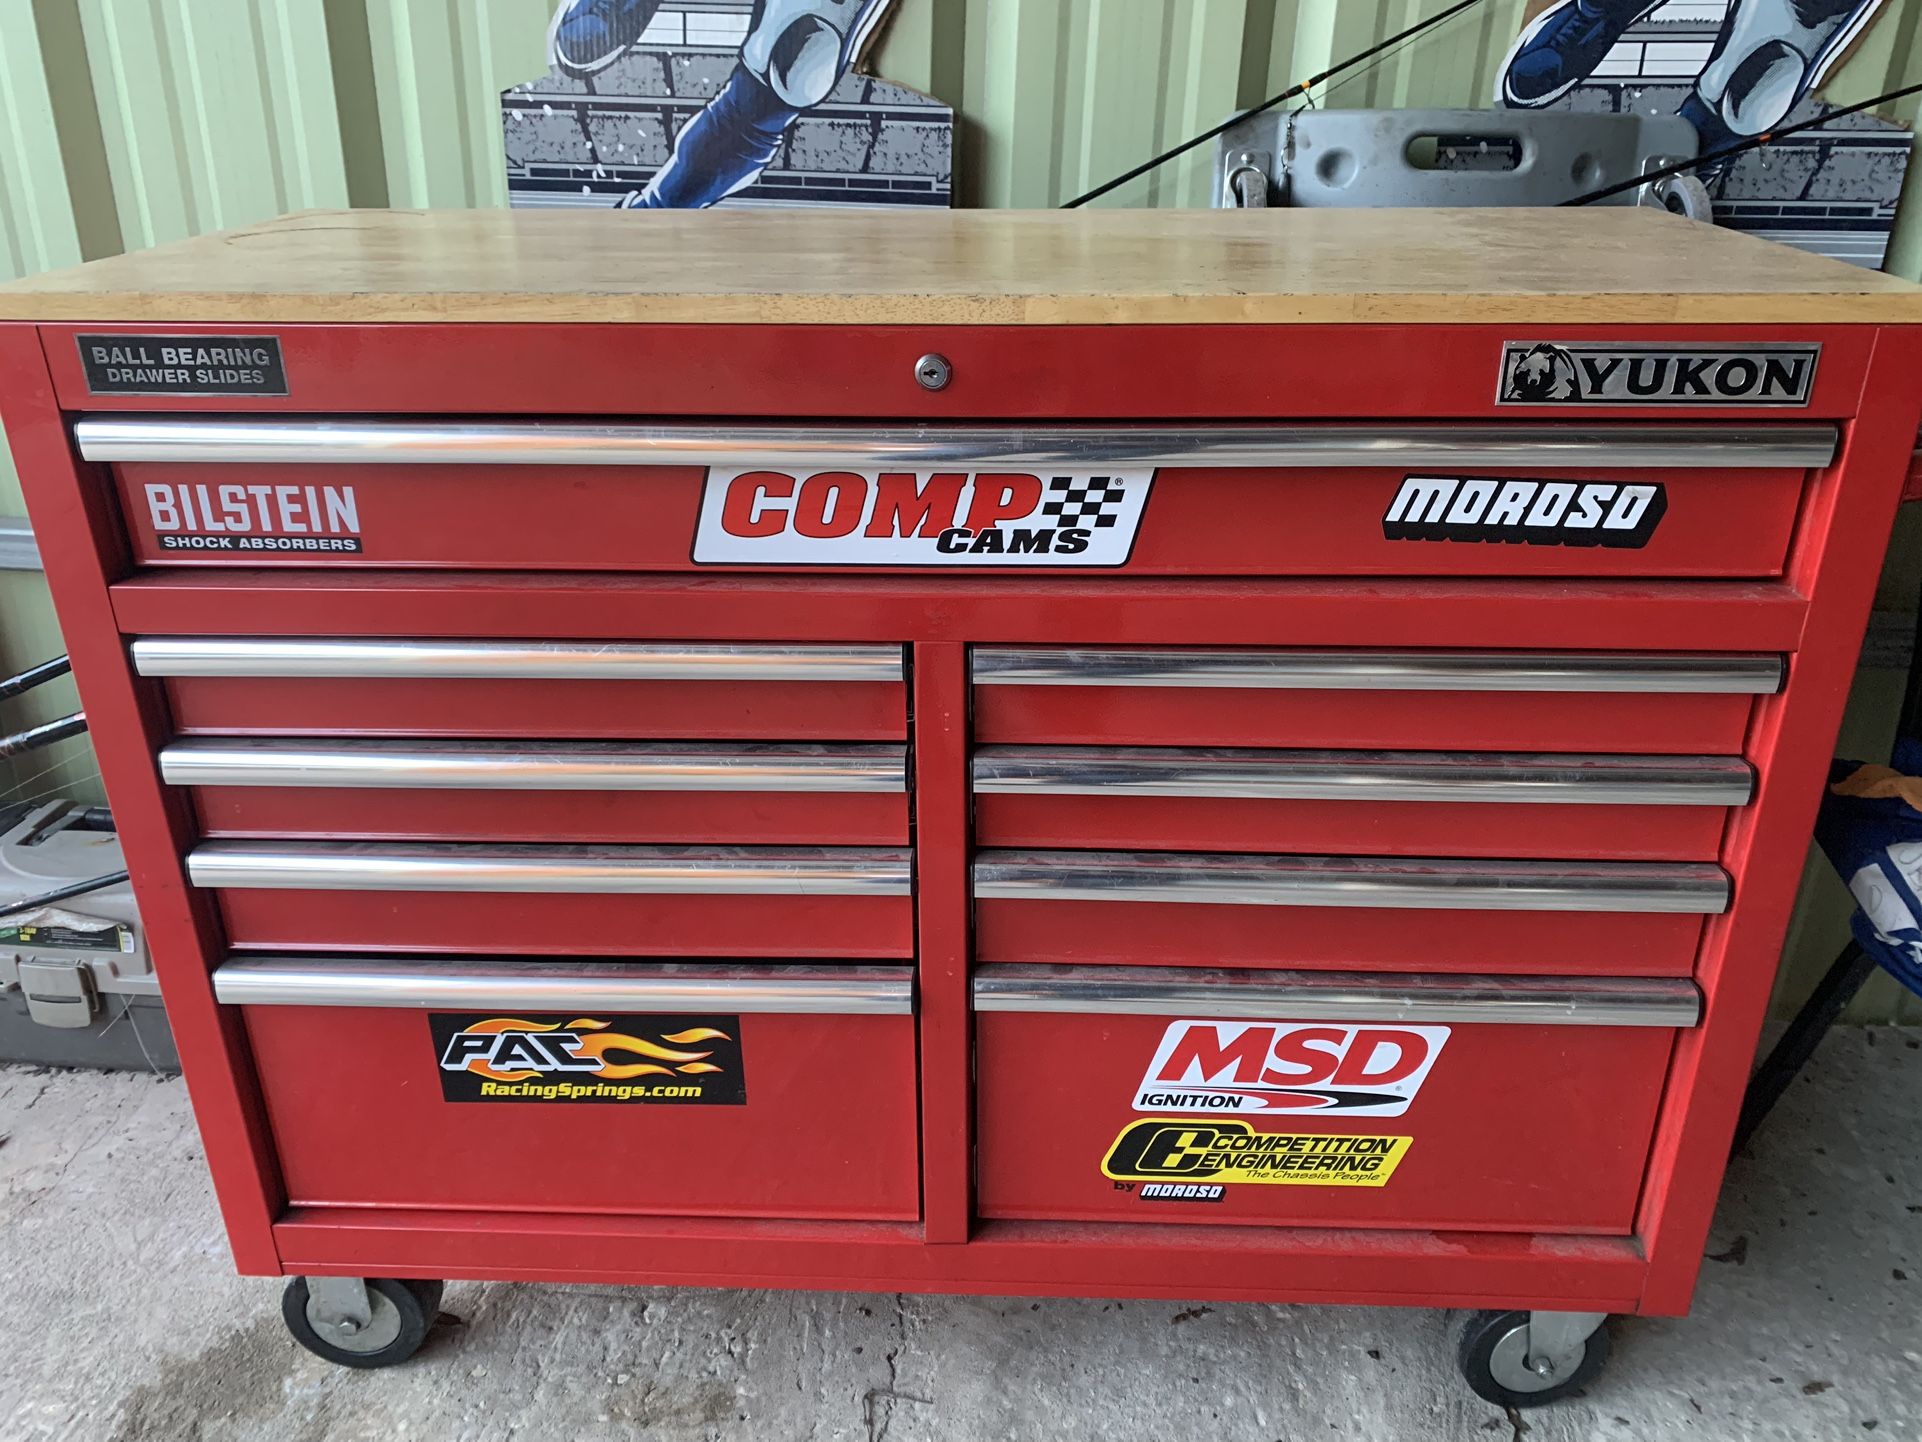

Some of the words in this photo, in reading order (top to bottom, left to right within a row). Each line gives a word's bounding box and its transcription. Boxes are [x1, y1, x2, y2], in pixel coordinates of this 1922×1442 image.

[91, 346, 155, 365] BALL
[161, 346, 271, 367] BEARING
[106, 368, 191, 384] DRAWER
[196, 369, 265, 385] SLIDES
[1579, 356, 1808, 397] YUKON
[143, 483, 361, 534] BILSTEIN
[720, 470, 1043, 539] COMP
[1384, 477, 1658, 531] MOROSO
[163, 535, 233, 549] SHOCK
[239, 536, 357, 551] ABSORBERS
[935, 526, 1091, 555] CAMS
[440, 1032, 606, 1072] PAC
[1155, 1025, 1430, 1086] MSD
[480, 1081, 702, 1100] RacingSprings.com
[1138, 1093, 1243, 1109] IGNITION
[1210, 1134, 1399, 1154] COMPETITION
[1200, 1152, 1385, 1172] ENGINEERING
[1246, 1169, 1269, 1178] The
[1272, 1169, 1329, 1180] Chassis
[1332, 1171, 1381, 1183] People
[1113, 1180, 1136, 1193] by
[1140, 1184, 1224, 1199] MOROSO
